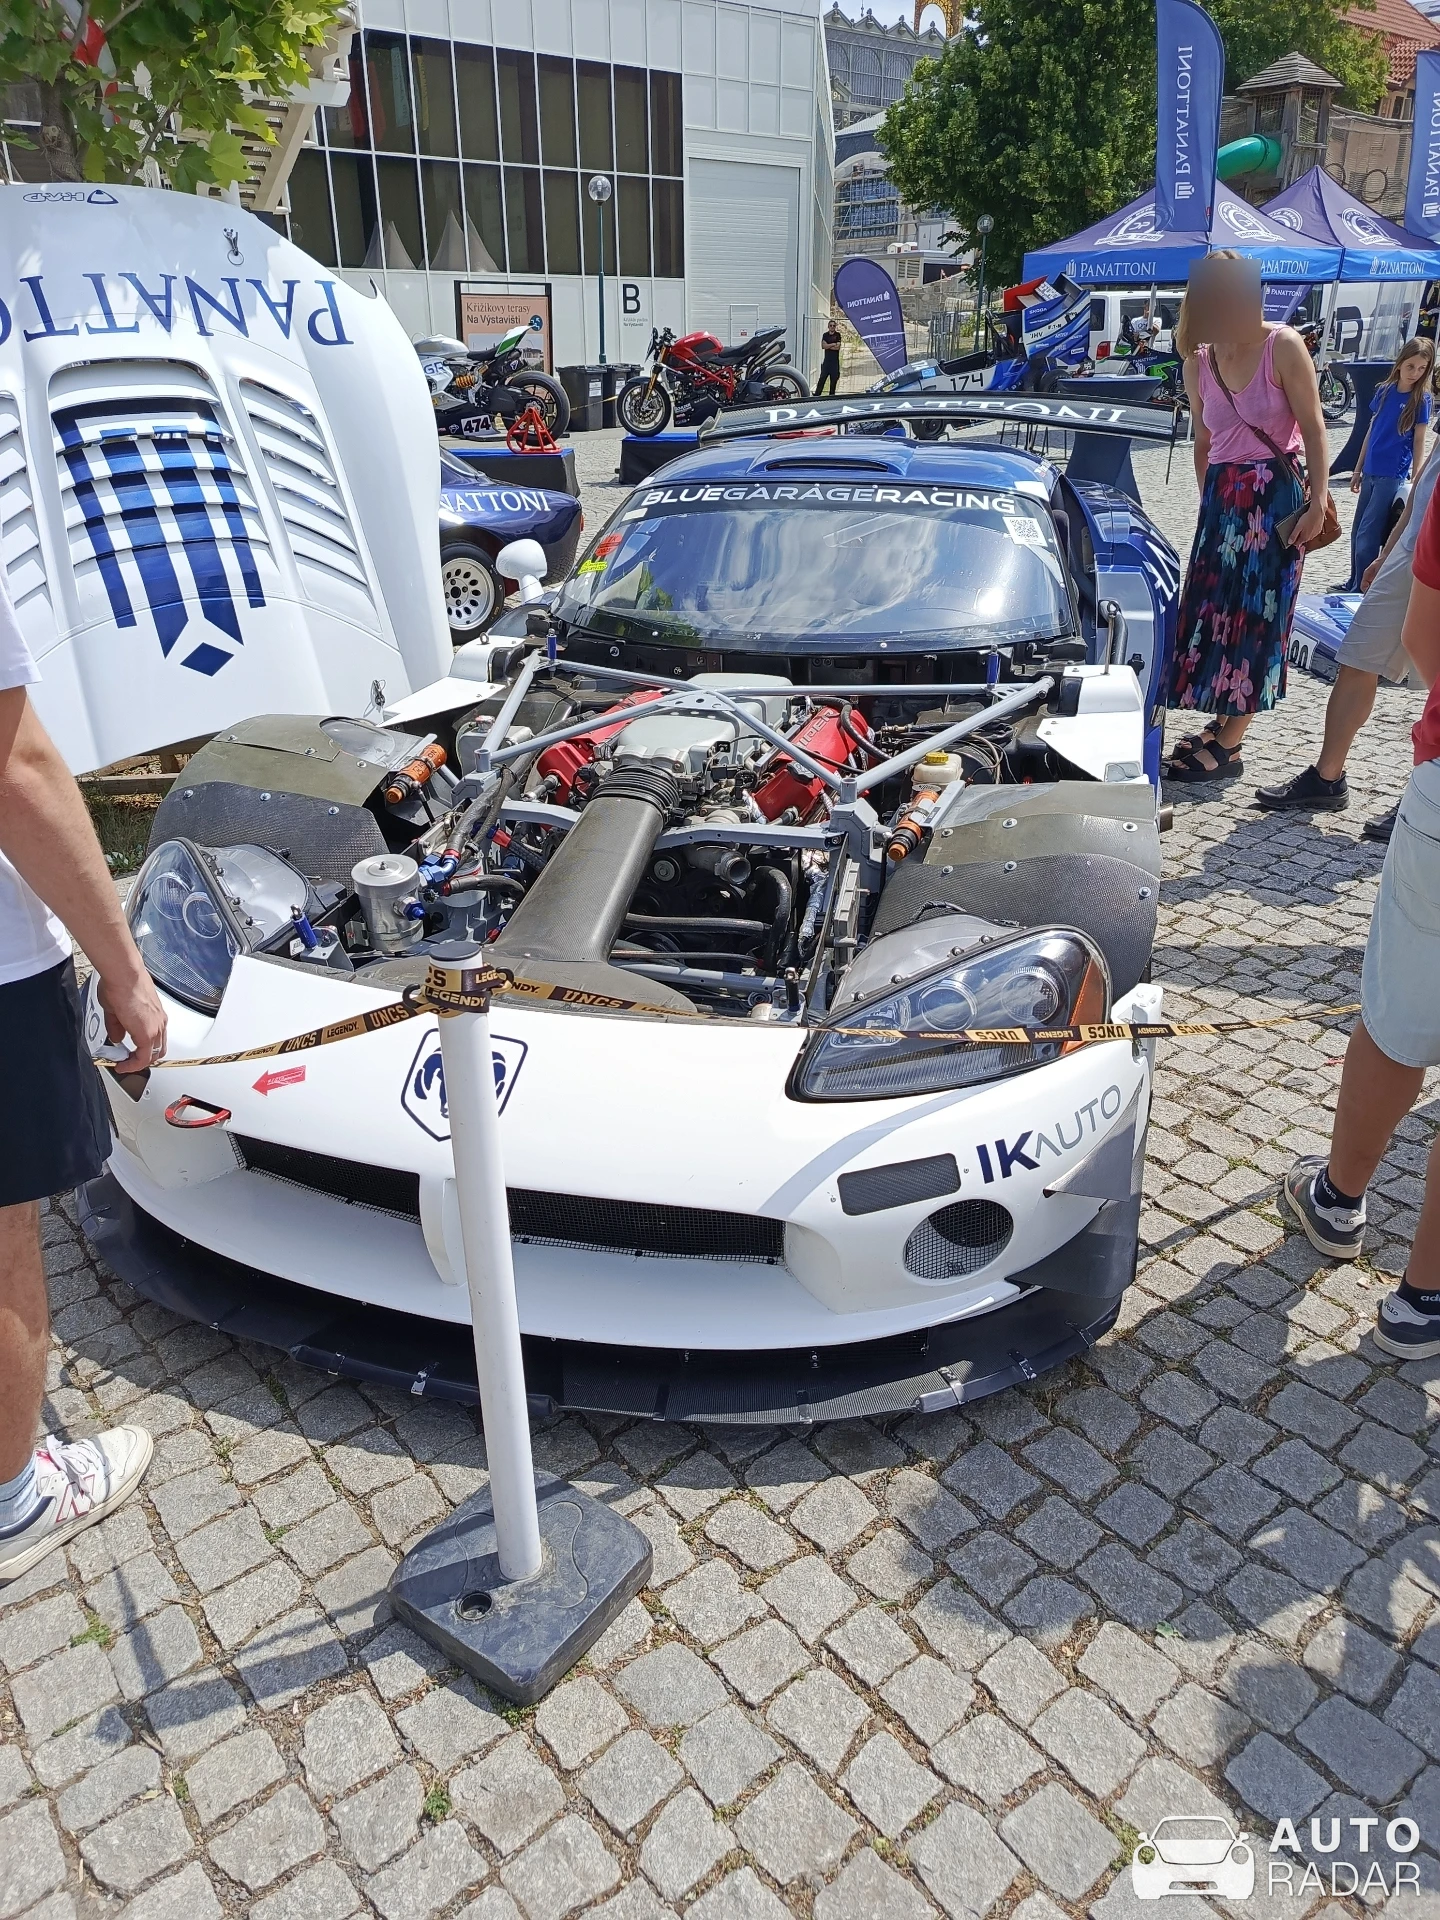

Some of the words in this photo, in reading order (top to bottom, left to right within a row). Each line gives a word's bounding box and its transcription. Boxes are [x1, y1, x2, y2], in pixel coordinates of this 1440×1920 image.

[1080, 261, 1157, 277] PANATTONI
[1259, 259, 1309, 275] ANATTONI
[1379, 260, 1425, 275] PANATTONI
[622, 283, 641, 314] B
[507, 303, 531, 315] terasy
[466, 315, 479, 324] Na
[480, 314, 521, 326] Výstavišti
[950, 372, 984, 391] 174
[463, 417, 491, 434] 474
[426, 986, 487, 1007] LEGENDY
[562, 988, 624, 1009] UNCS
[285, 1032, 317, 1052] UNCS
[370, 1003, 411, 1029] UNCS
[975, 1030, 1019, 1041] UNCS
[1088, 1025, 1126, 1039] UNCS
[1178, 1024, 1211, 1035] UNCS
[1334, 1217, 1355, 1225] Polo
